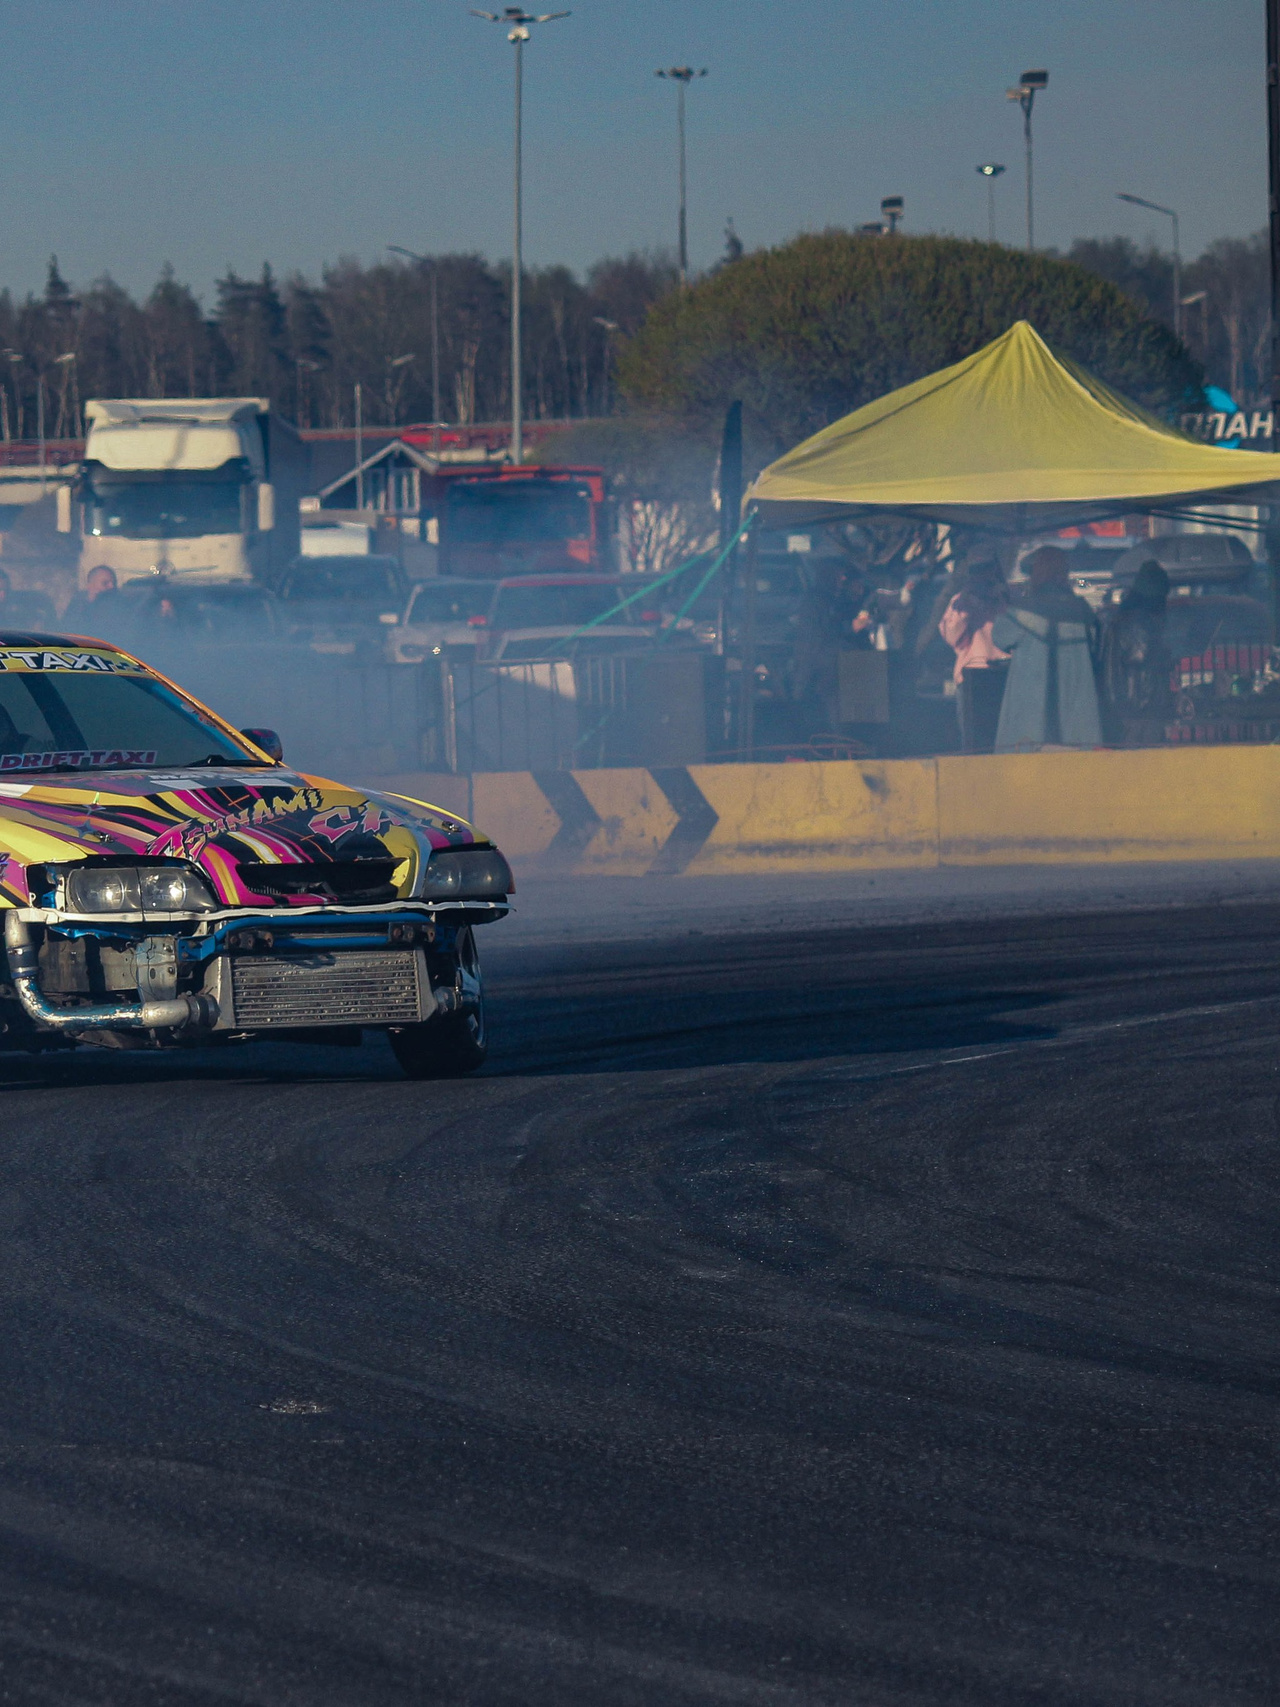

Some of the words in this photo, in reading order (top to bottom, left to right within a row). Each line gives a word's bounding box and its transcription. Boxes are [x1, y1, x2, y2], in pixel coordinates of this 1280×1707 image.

[10, 651, 113, 671] TAXI
[0, 752, 85, 769] DRIFT
[90, 751, 156, 764] TAXI
